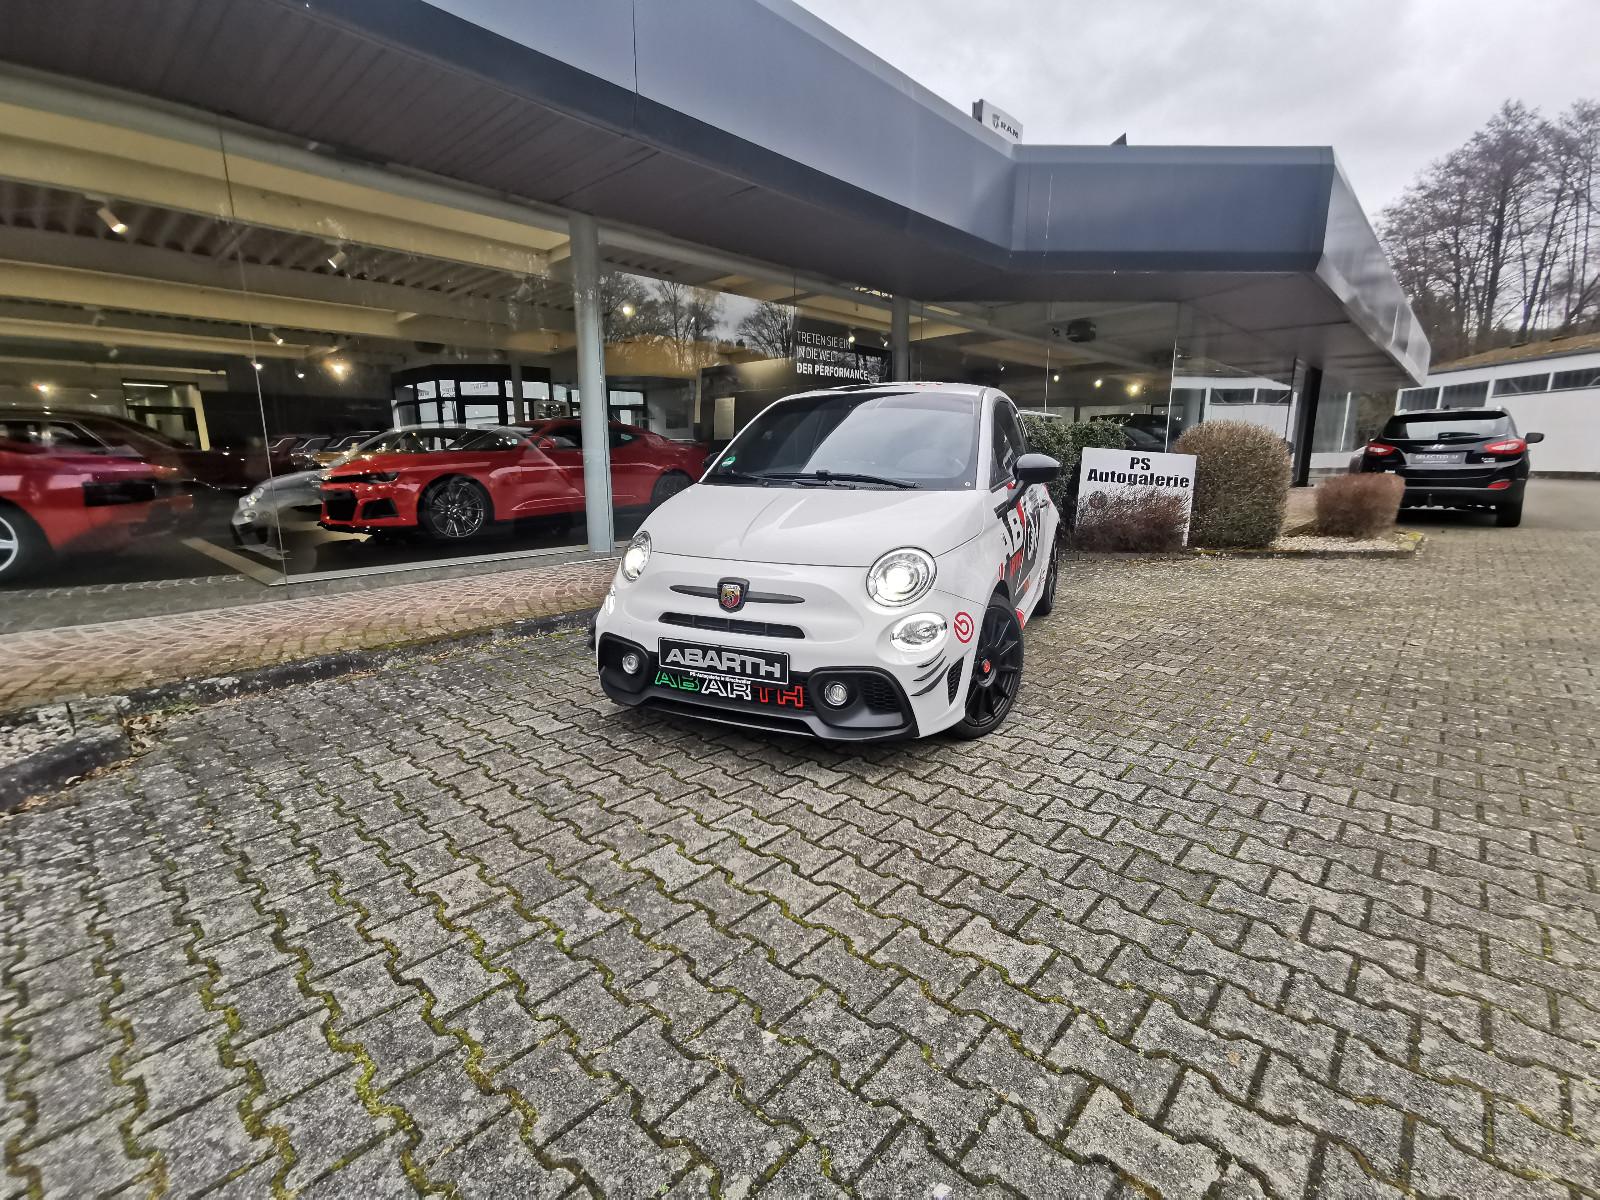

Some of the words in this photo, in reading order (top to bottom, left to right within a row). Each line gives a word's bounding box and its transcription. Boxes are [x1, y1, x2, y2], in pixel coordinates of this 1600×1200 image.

[1001, 121, 1018, 139] RAM
[797, 331, 826, 345] TRETEN
[827, 336, 838, 347] SIE
[839, 338, 851, 349] EIN
[796, 345, 805, 358] IN
[806, 346, 818, 360] DIE
[797, 363, 813, 374] DER
[1129, 456, 1151, 471] PS
[1087, 468, 1190, 488] Autogalerie
[665, 648, 780, 677] ABARTH
[655, 671, 804, 708] ABARTH
